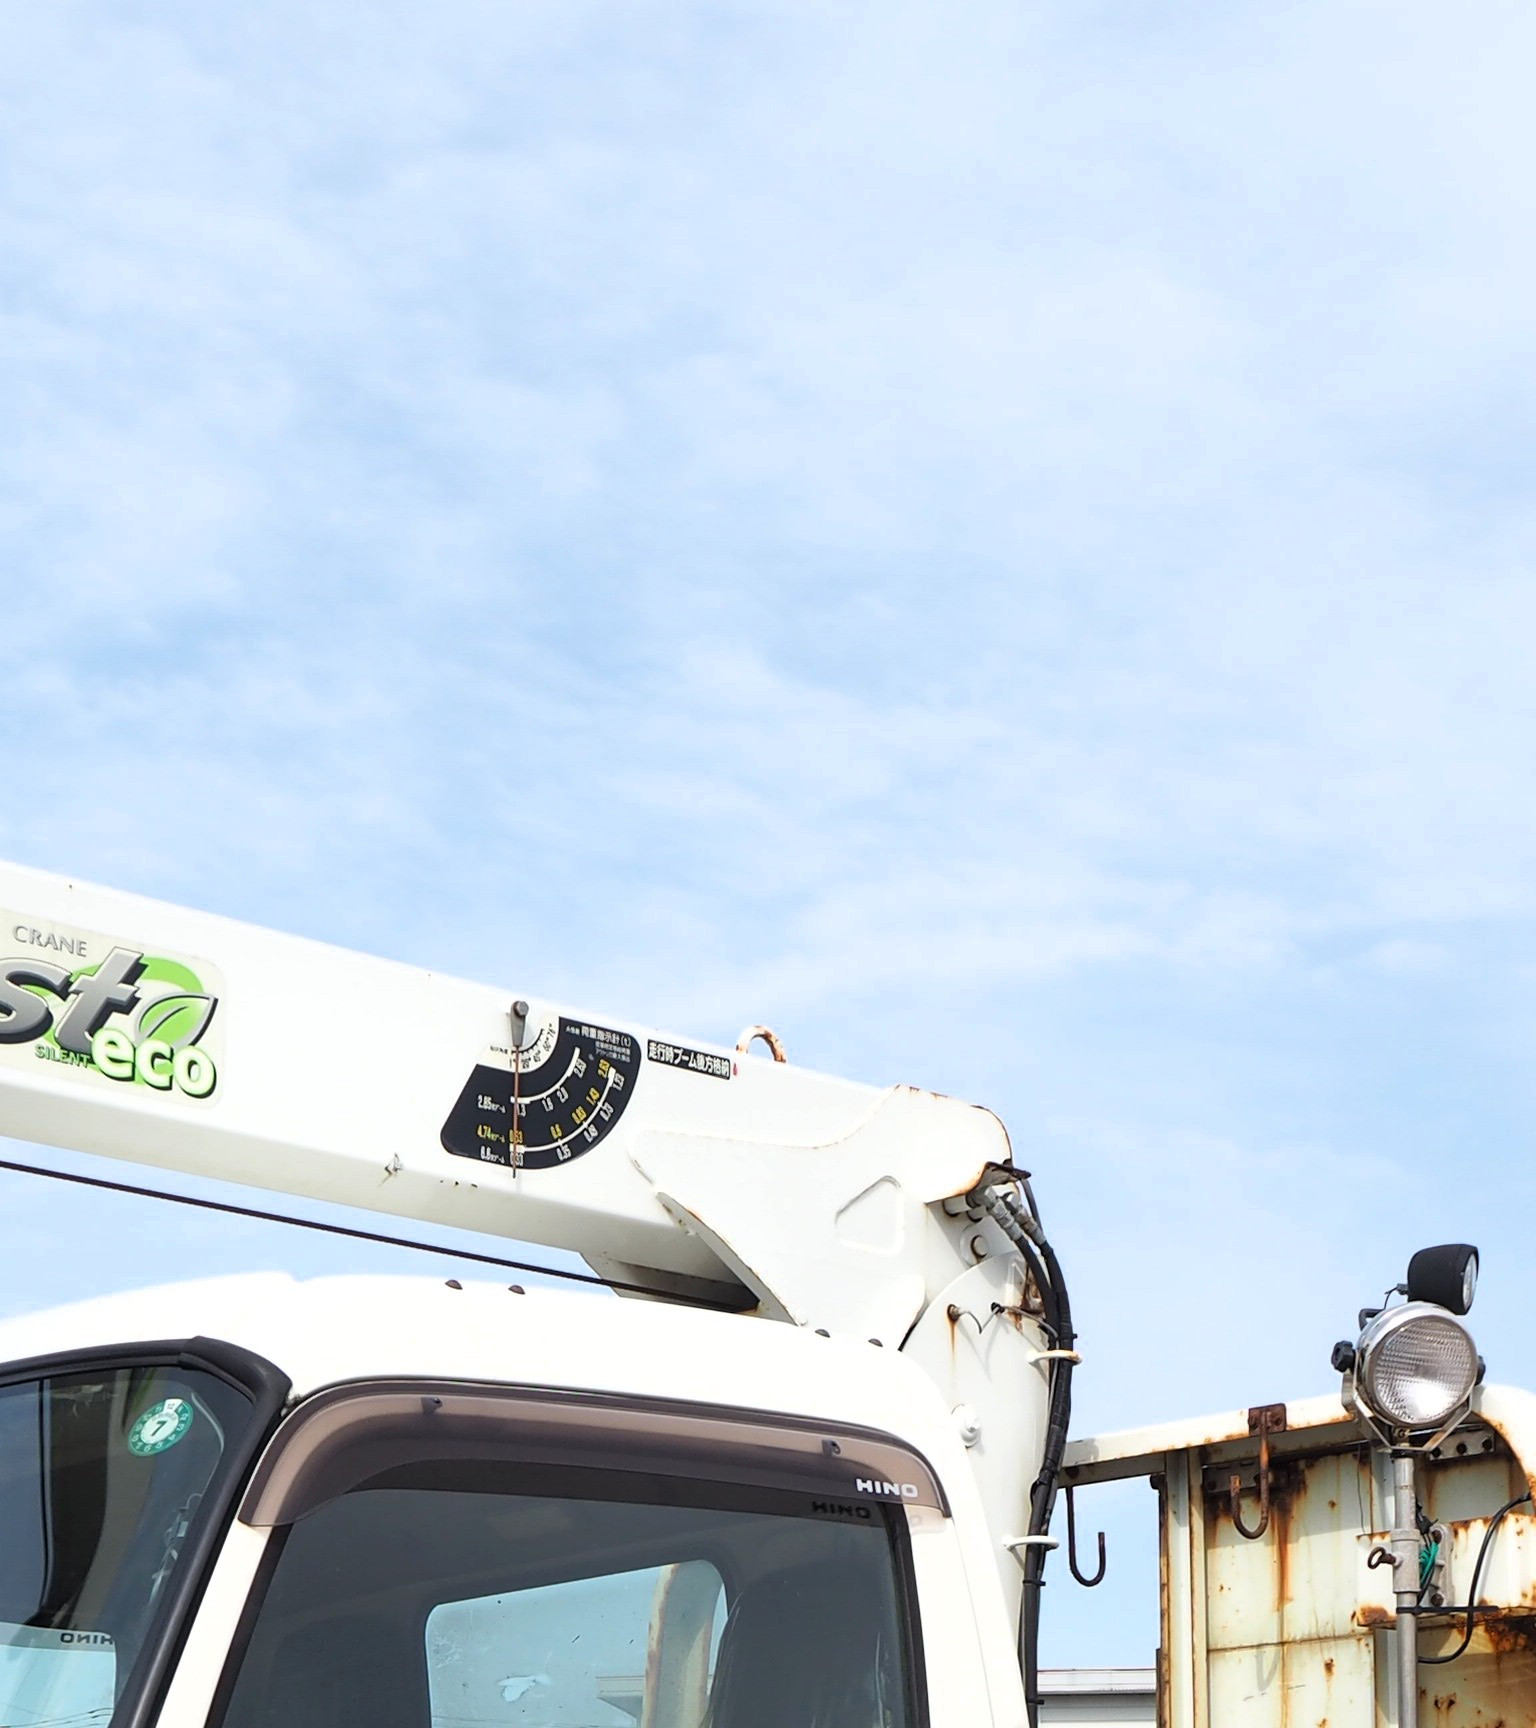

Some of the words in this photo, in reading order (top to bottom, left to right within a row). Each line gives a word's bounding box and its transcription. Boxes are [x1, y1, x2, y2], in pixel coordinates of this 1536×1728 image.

[11, 923, 88, 958] CRANE
[34, 1043, 92, 1069] SILENT
[91, 1028, 217, 1099] eco
[151, 1420, 168, 1437] 7
[855, 1477, 918, 1498] HINO
